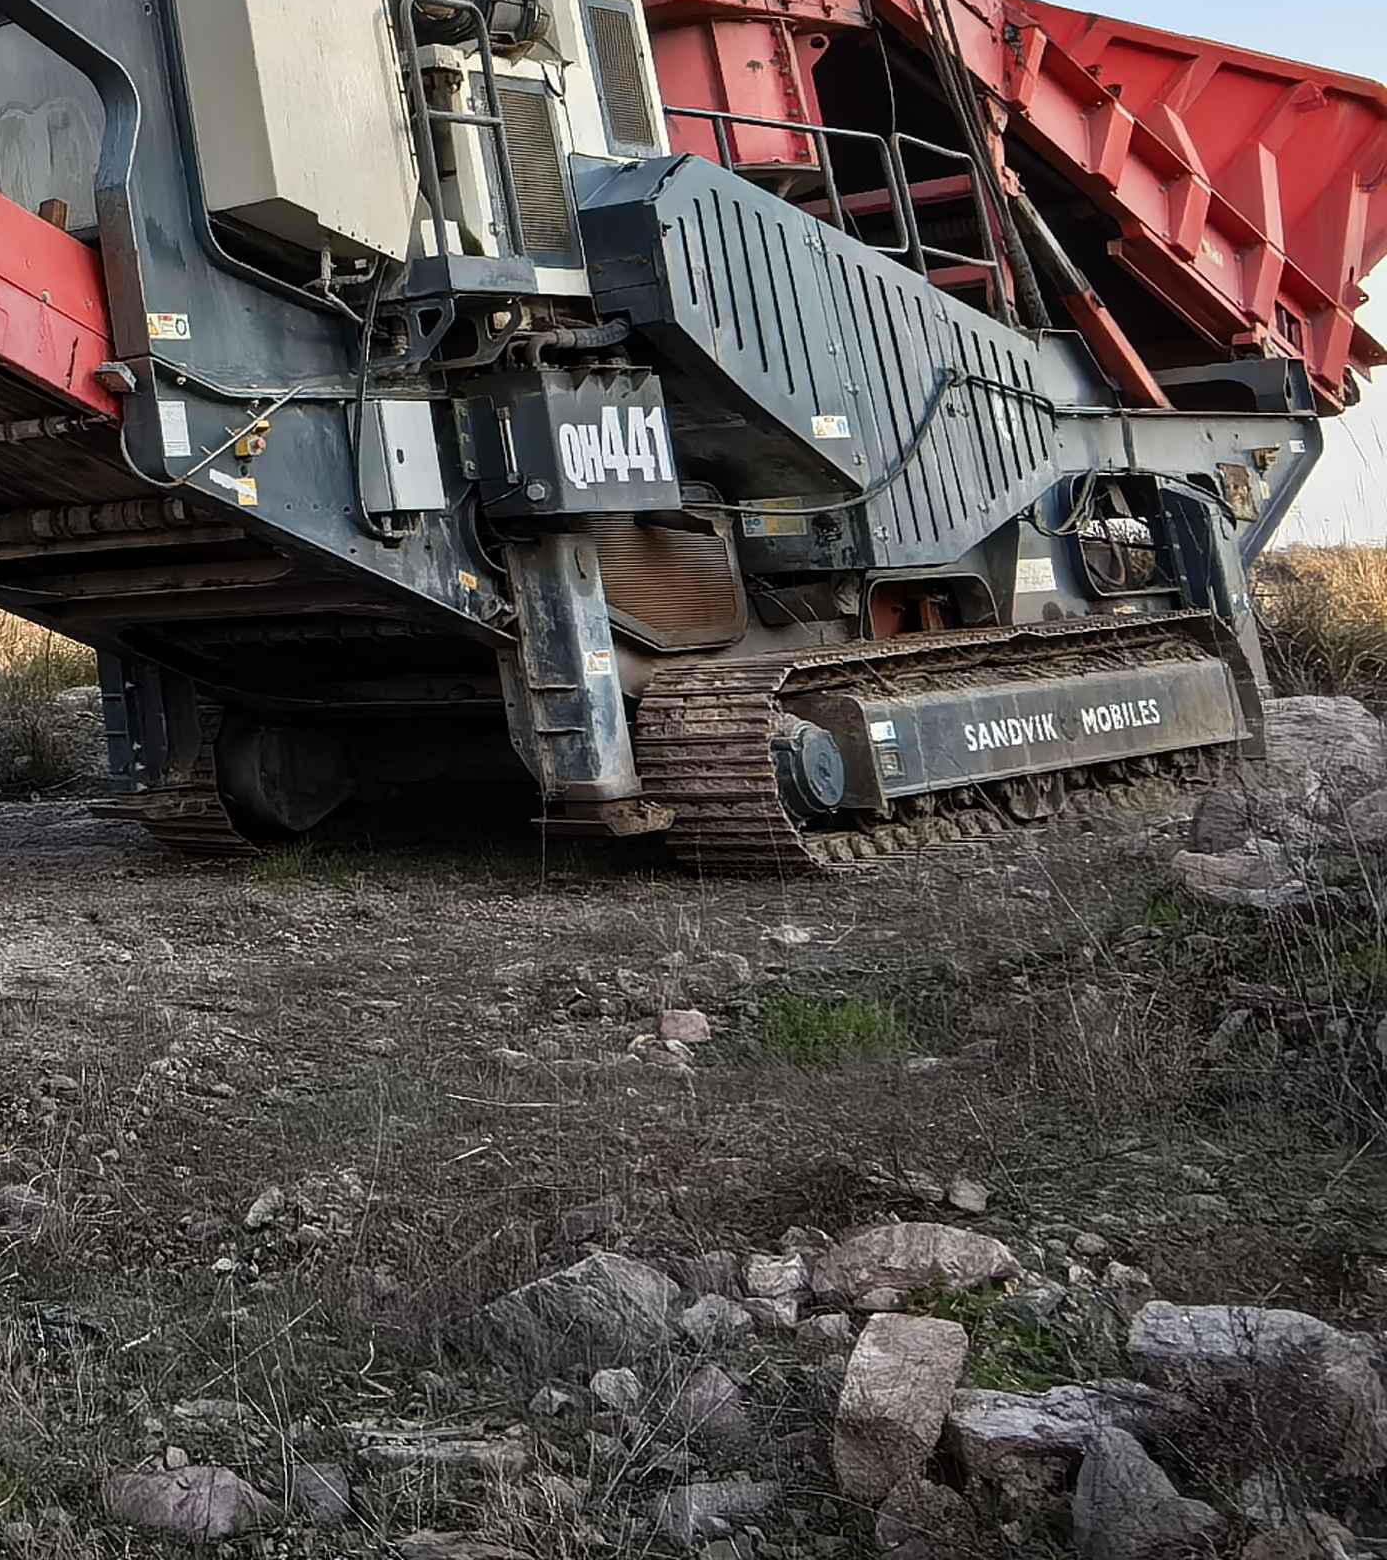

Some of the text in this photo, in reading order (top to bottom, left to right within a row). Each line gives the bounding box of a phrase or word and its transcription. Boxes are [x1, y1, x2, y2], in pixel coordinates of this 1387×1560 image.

[558, 405, 673, 490] QH441
[964, 698, 1161, 752] SANDVIK MOBILES
